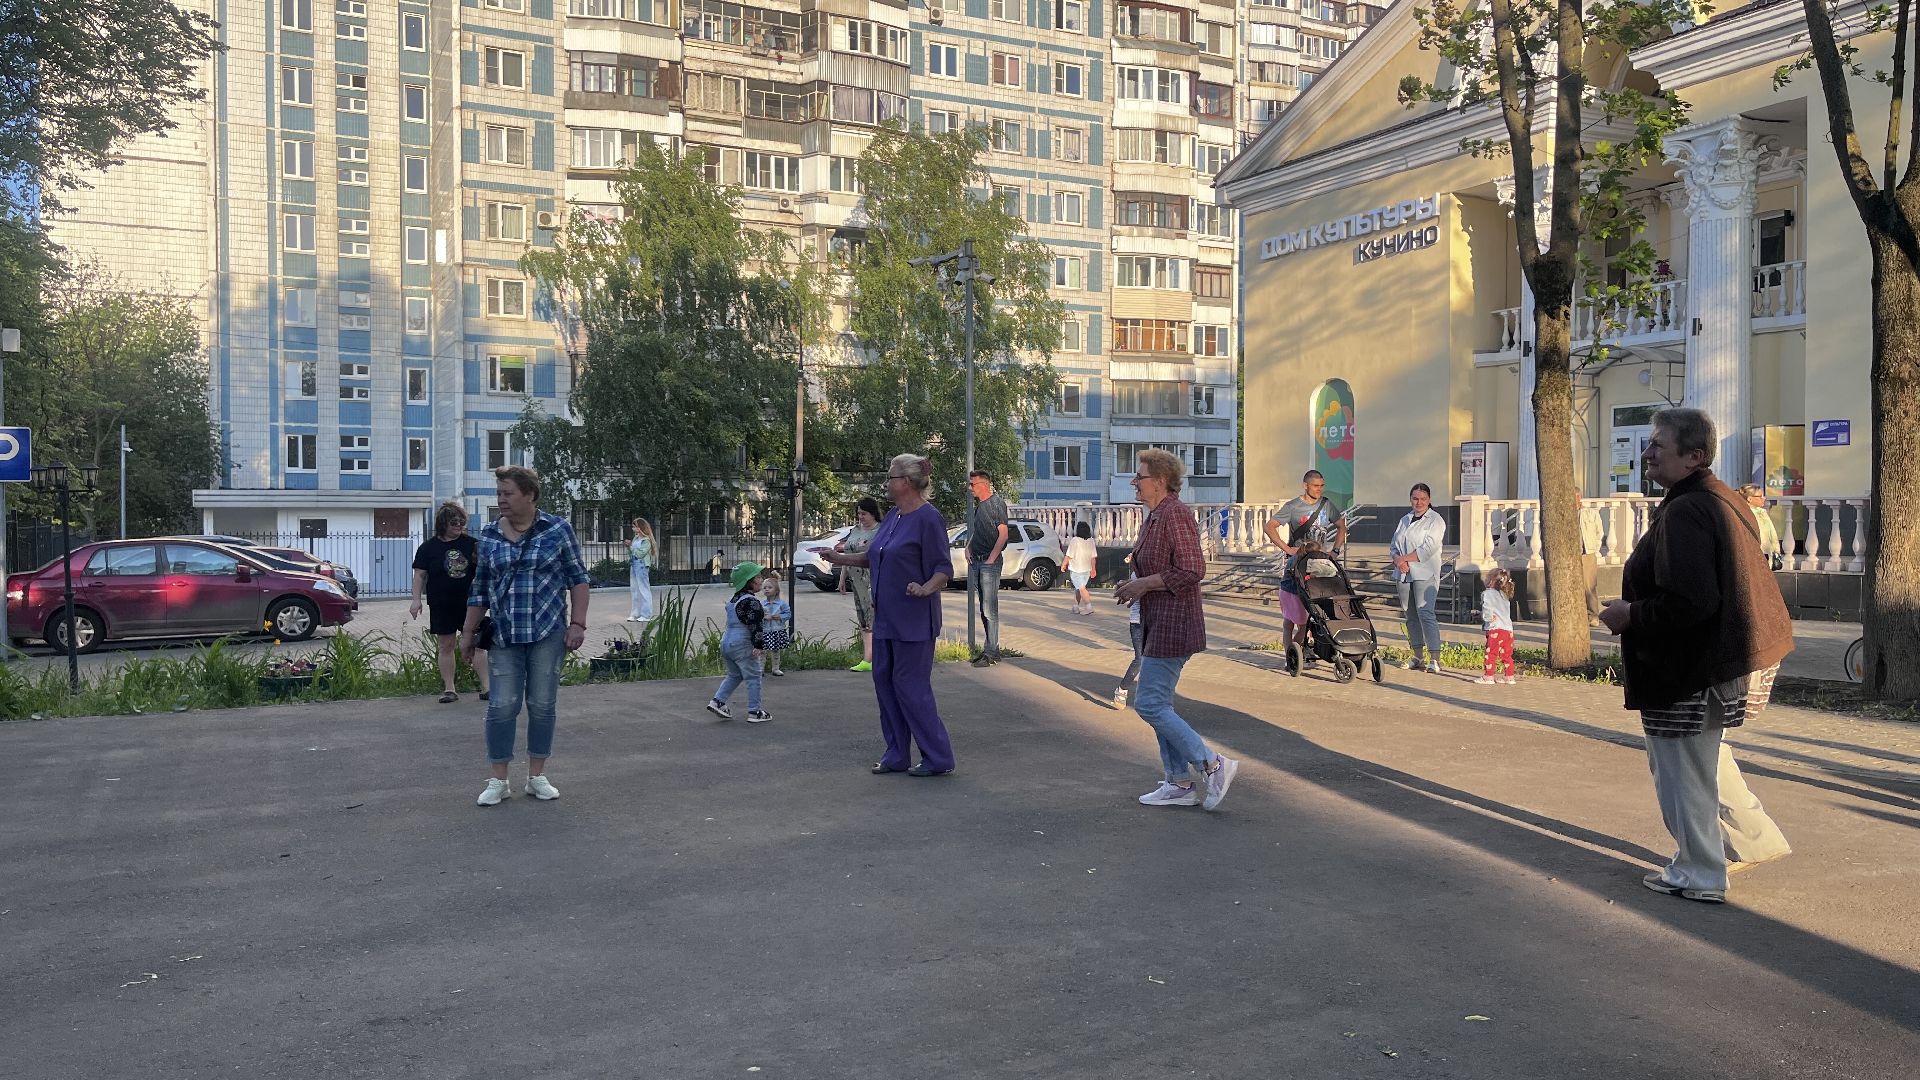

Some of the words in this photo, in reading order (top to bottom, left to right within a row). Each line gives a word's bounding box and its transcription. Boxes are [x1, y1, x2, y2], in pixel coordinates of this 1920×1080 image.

[1261, 229, 1308, 260] ДОМ
[1311, 191, 1441, 248] КУЛЬТУРЫ
[1358, 225, 1441, 262] КУЧИНО
